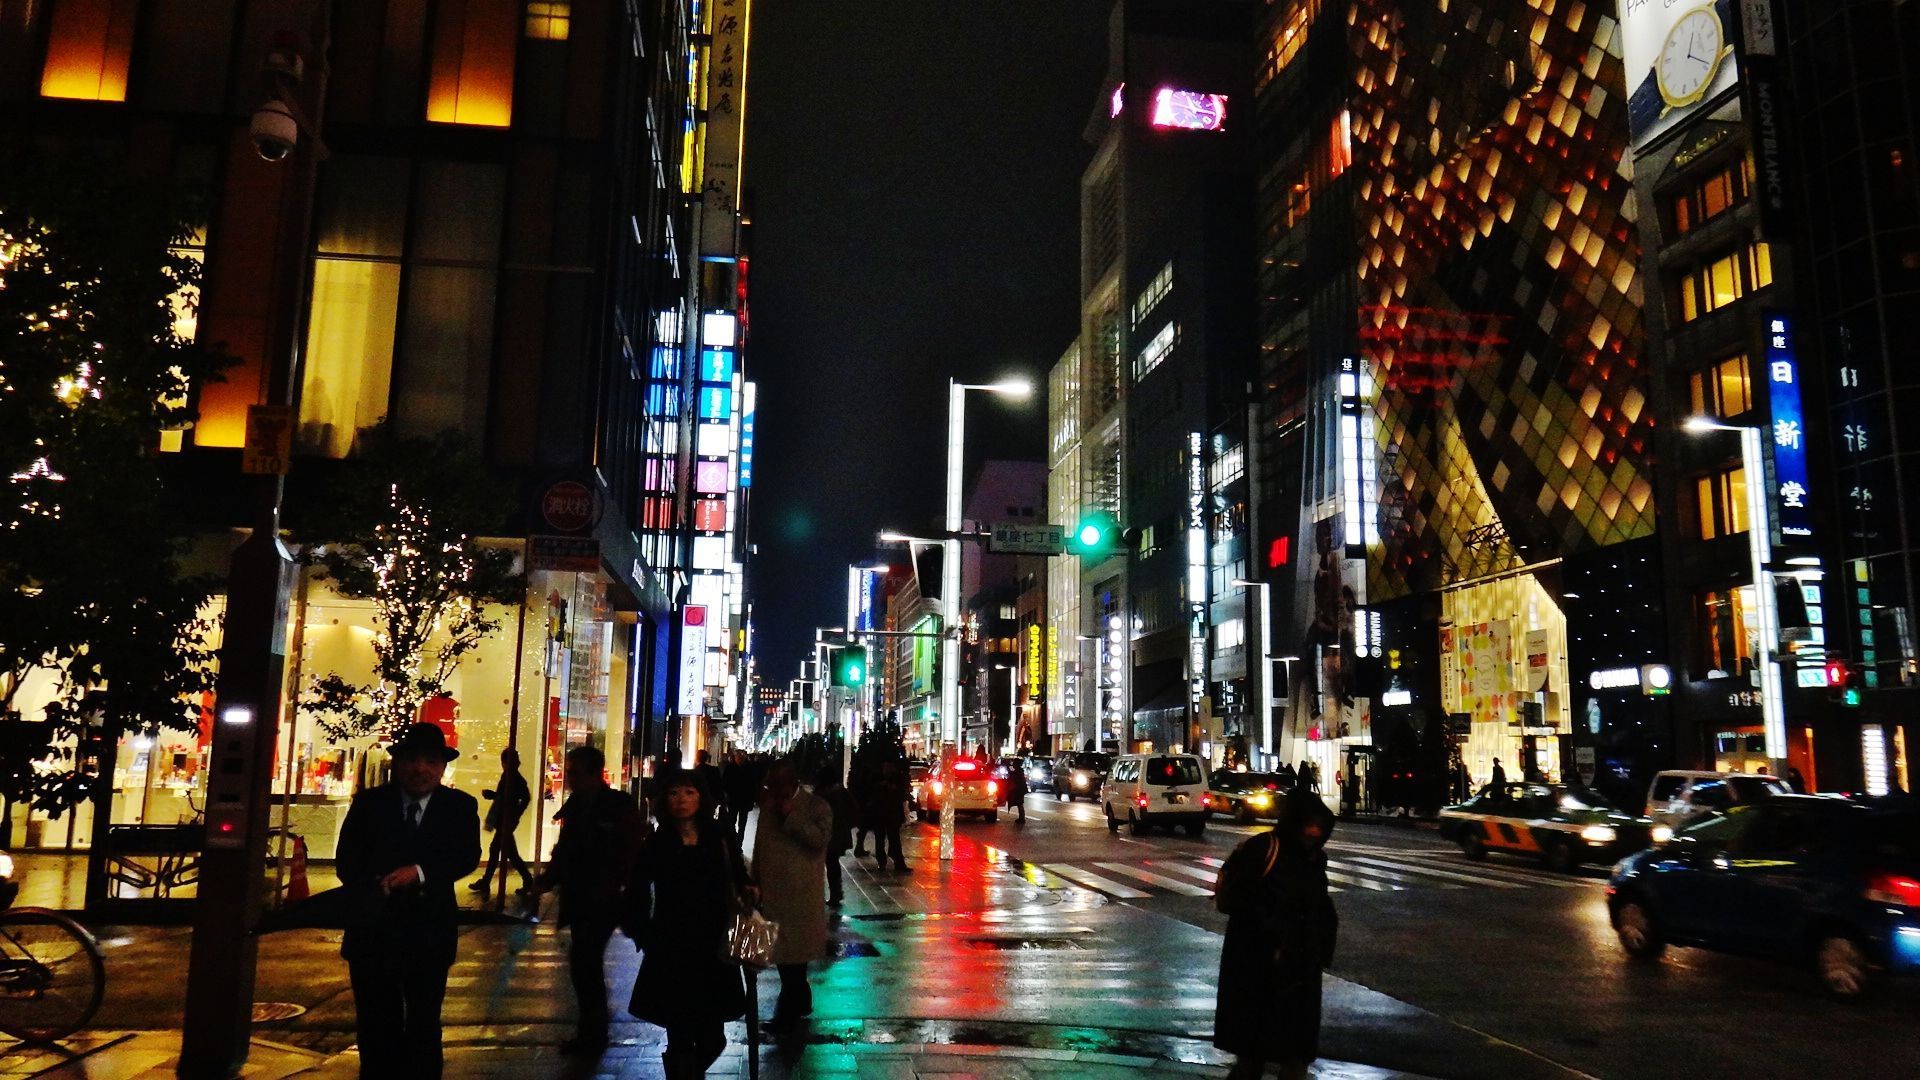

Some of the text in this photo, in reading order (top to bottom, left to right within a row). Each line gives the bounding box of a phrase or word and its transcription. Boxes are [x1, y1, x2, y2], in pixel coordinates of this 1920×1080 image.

[1757, 81, 1783, 194] MONTBLANC
[1771, 319, 1807, 508] 銀座 日新堂
[1053, 419, 1075, 453] ZARA
[548, 495, 593, 515] 消火栓
[996, 530, 1061, 544] 銀座七丁目
[1065, 675, 1076, 718] ZARA
